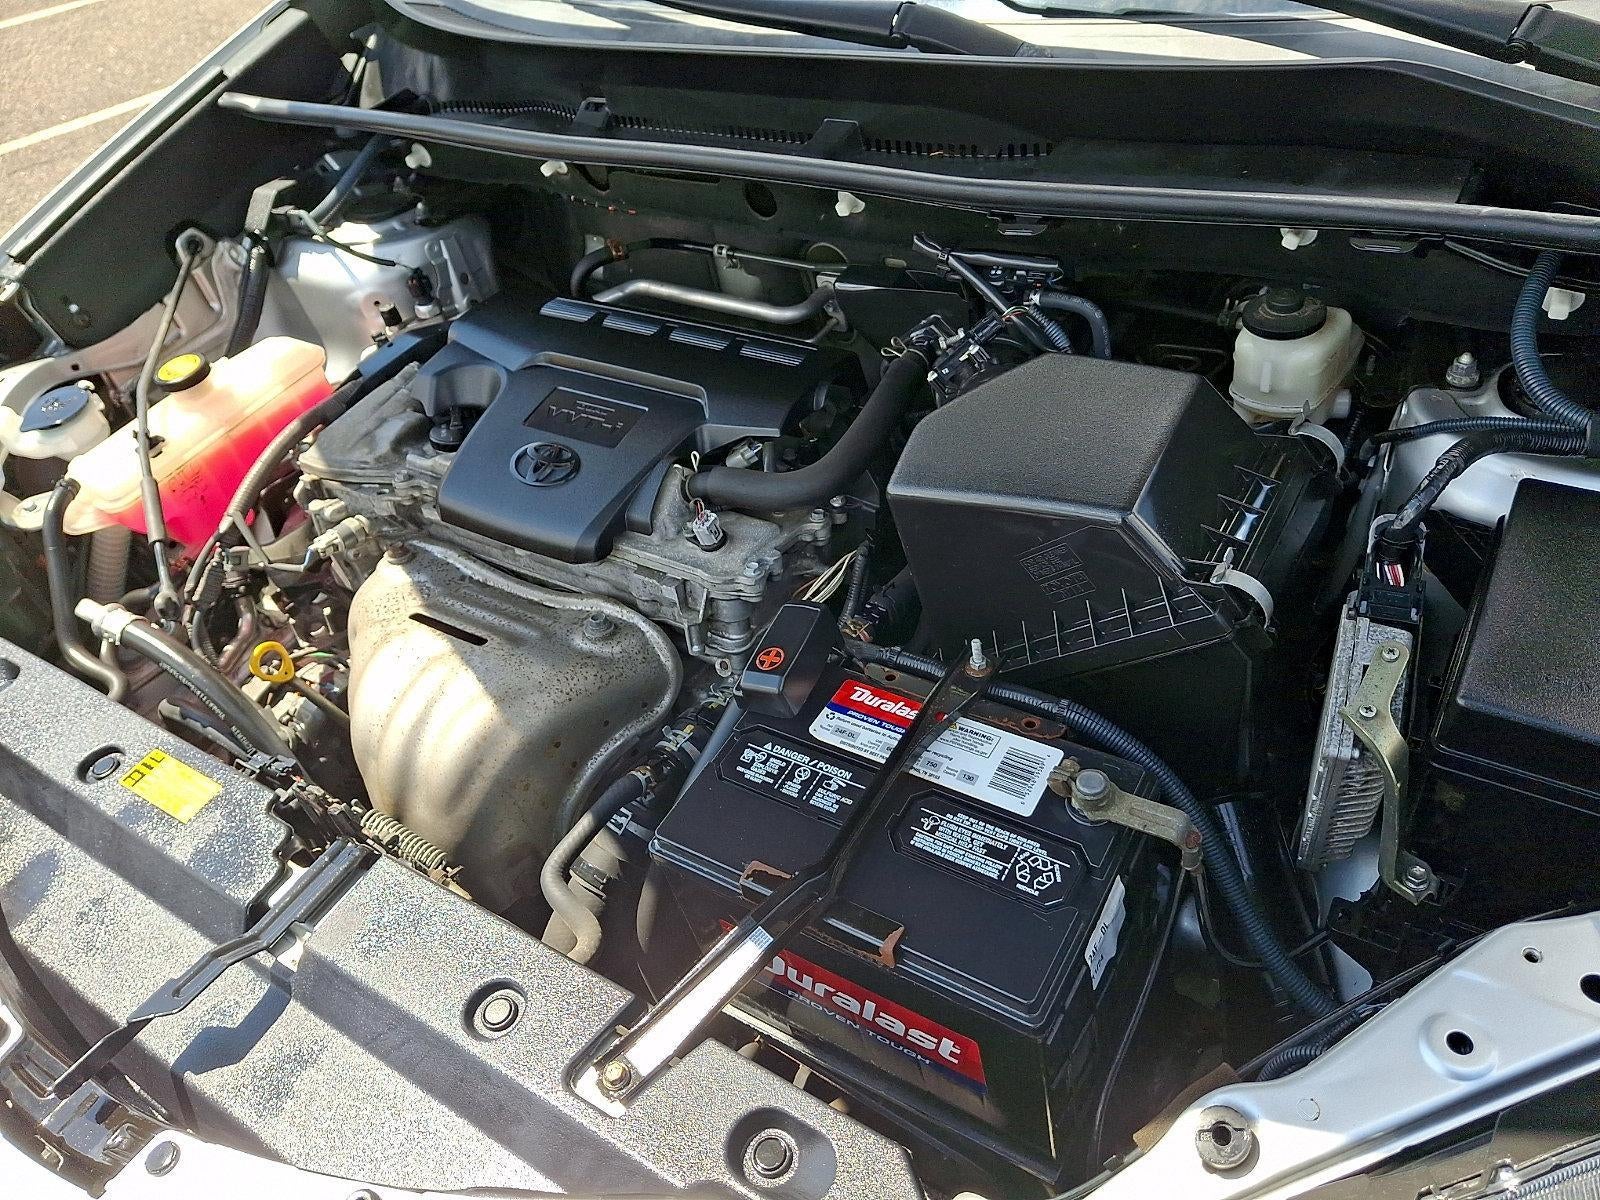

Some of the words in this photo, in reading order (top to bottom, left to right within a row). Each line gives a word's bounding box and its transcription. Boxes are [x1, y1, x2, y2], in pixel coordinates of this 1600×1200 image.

[850, 686, 919, 720] Duralas
[846, 710, 880, 725] PROVEN
[834, 727, 856, 739] 24F-DL
[959, 726, 994, 741] WARNING:
[773, 745, 810, 764] DANGER
[817, 761, 852, 780] POISON
[926, 761, 938, 769] 750
[962, 773, 975, 782] 130
[787, 989, 860, 1029] PROVEN
[865, 1029, 931, 1065] TOUGH
